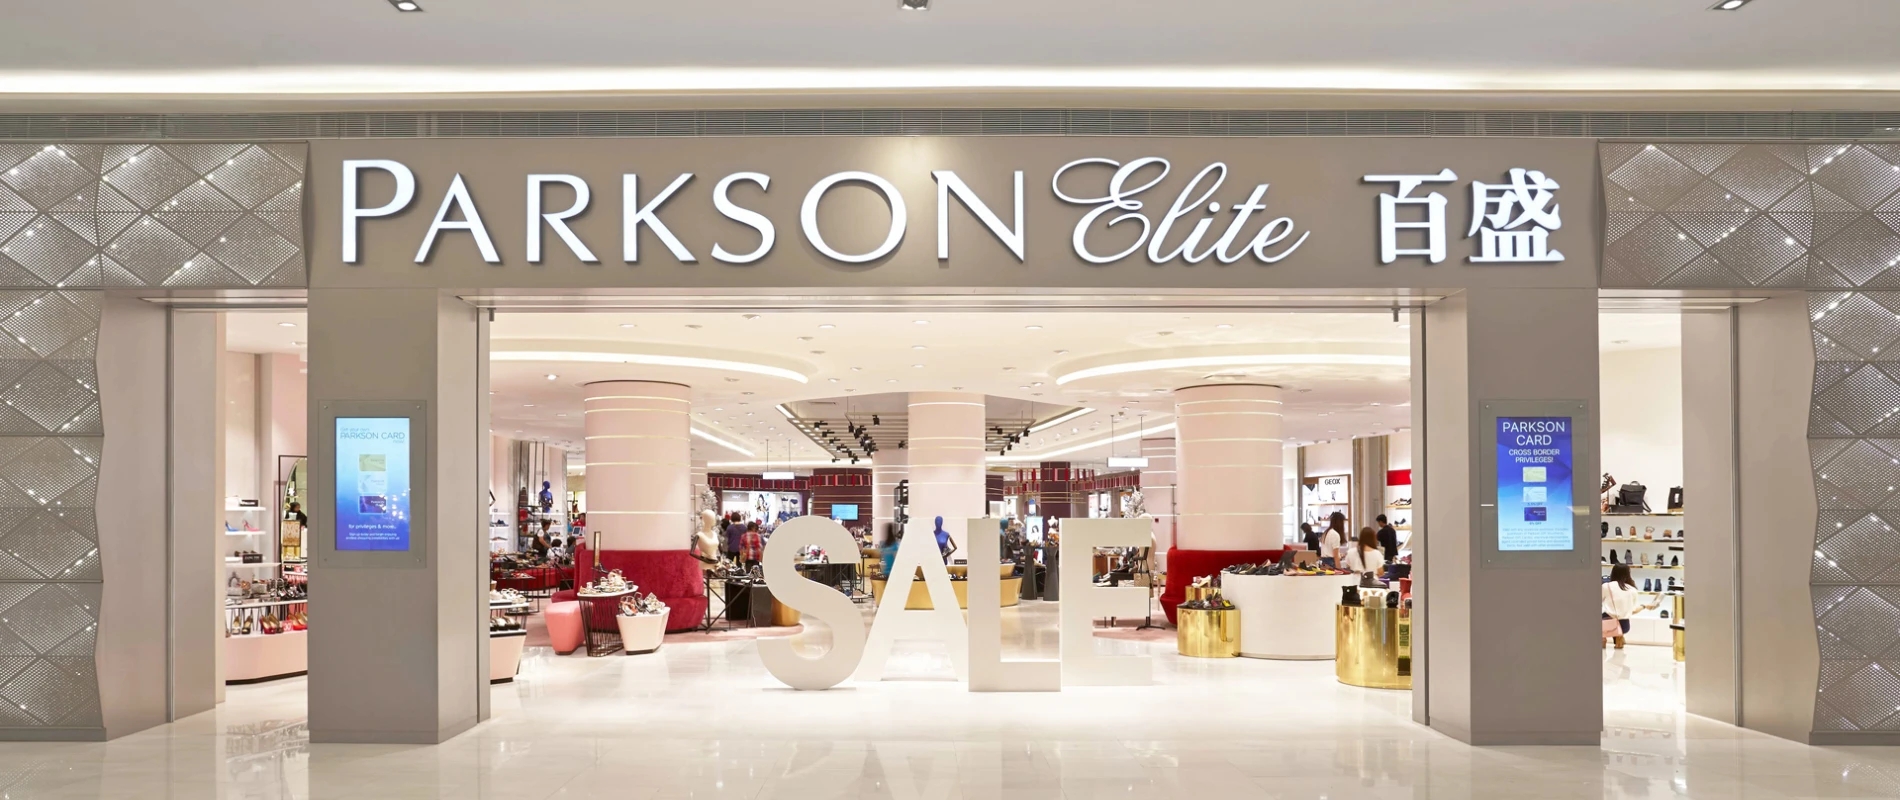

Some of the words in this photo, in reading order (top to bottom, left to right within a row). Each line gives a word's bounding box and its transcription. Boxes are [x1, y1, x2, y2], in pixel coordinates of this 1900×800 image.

[342, 159, 1025, 264] PARKSON
[1052, 156, 1311, 264] Elite
[1363, 167, 1566, 264] 百盛
[1503, 421, 1565, 433] PARKSON
[340, 432, 379, 440] PARKSON
[381, 432, 405, 440] CARD
[1516, 434, 1552, 446] CARD
[1324, 478, 1341, 486] GEOX
[757, 515, 1153, 692] SALE
